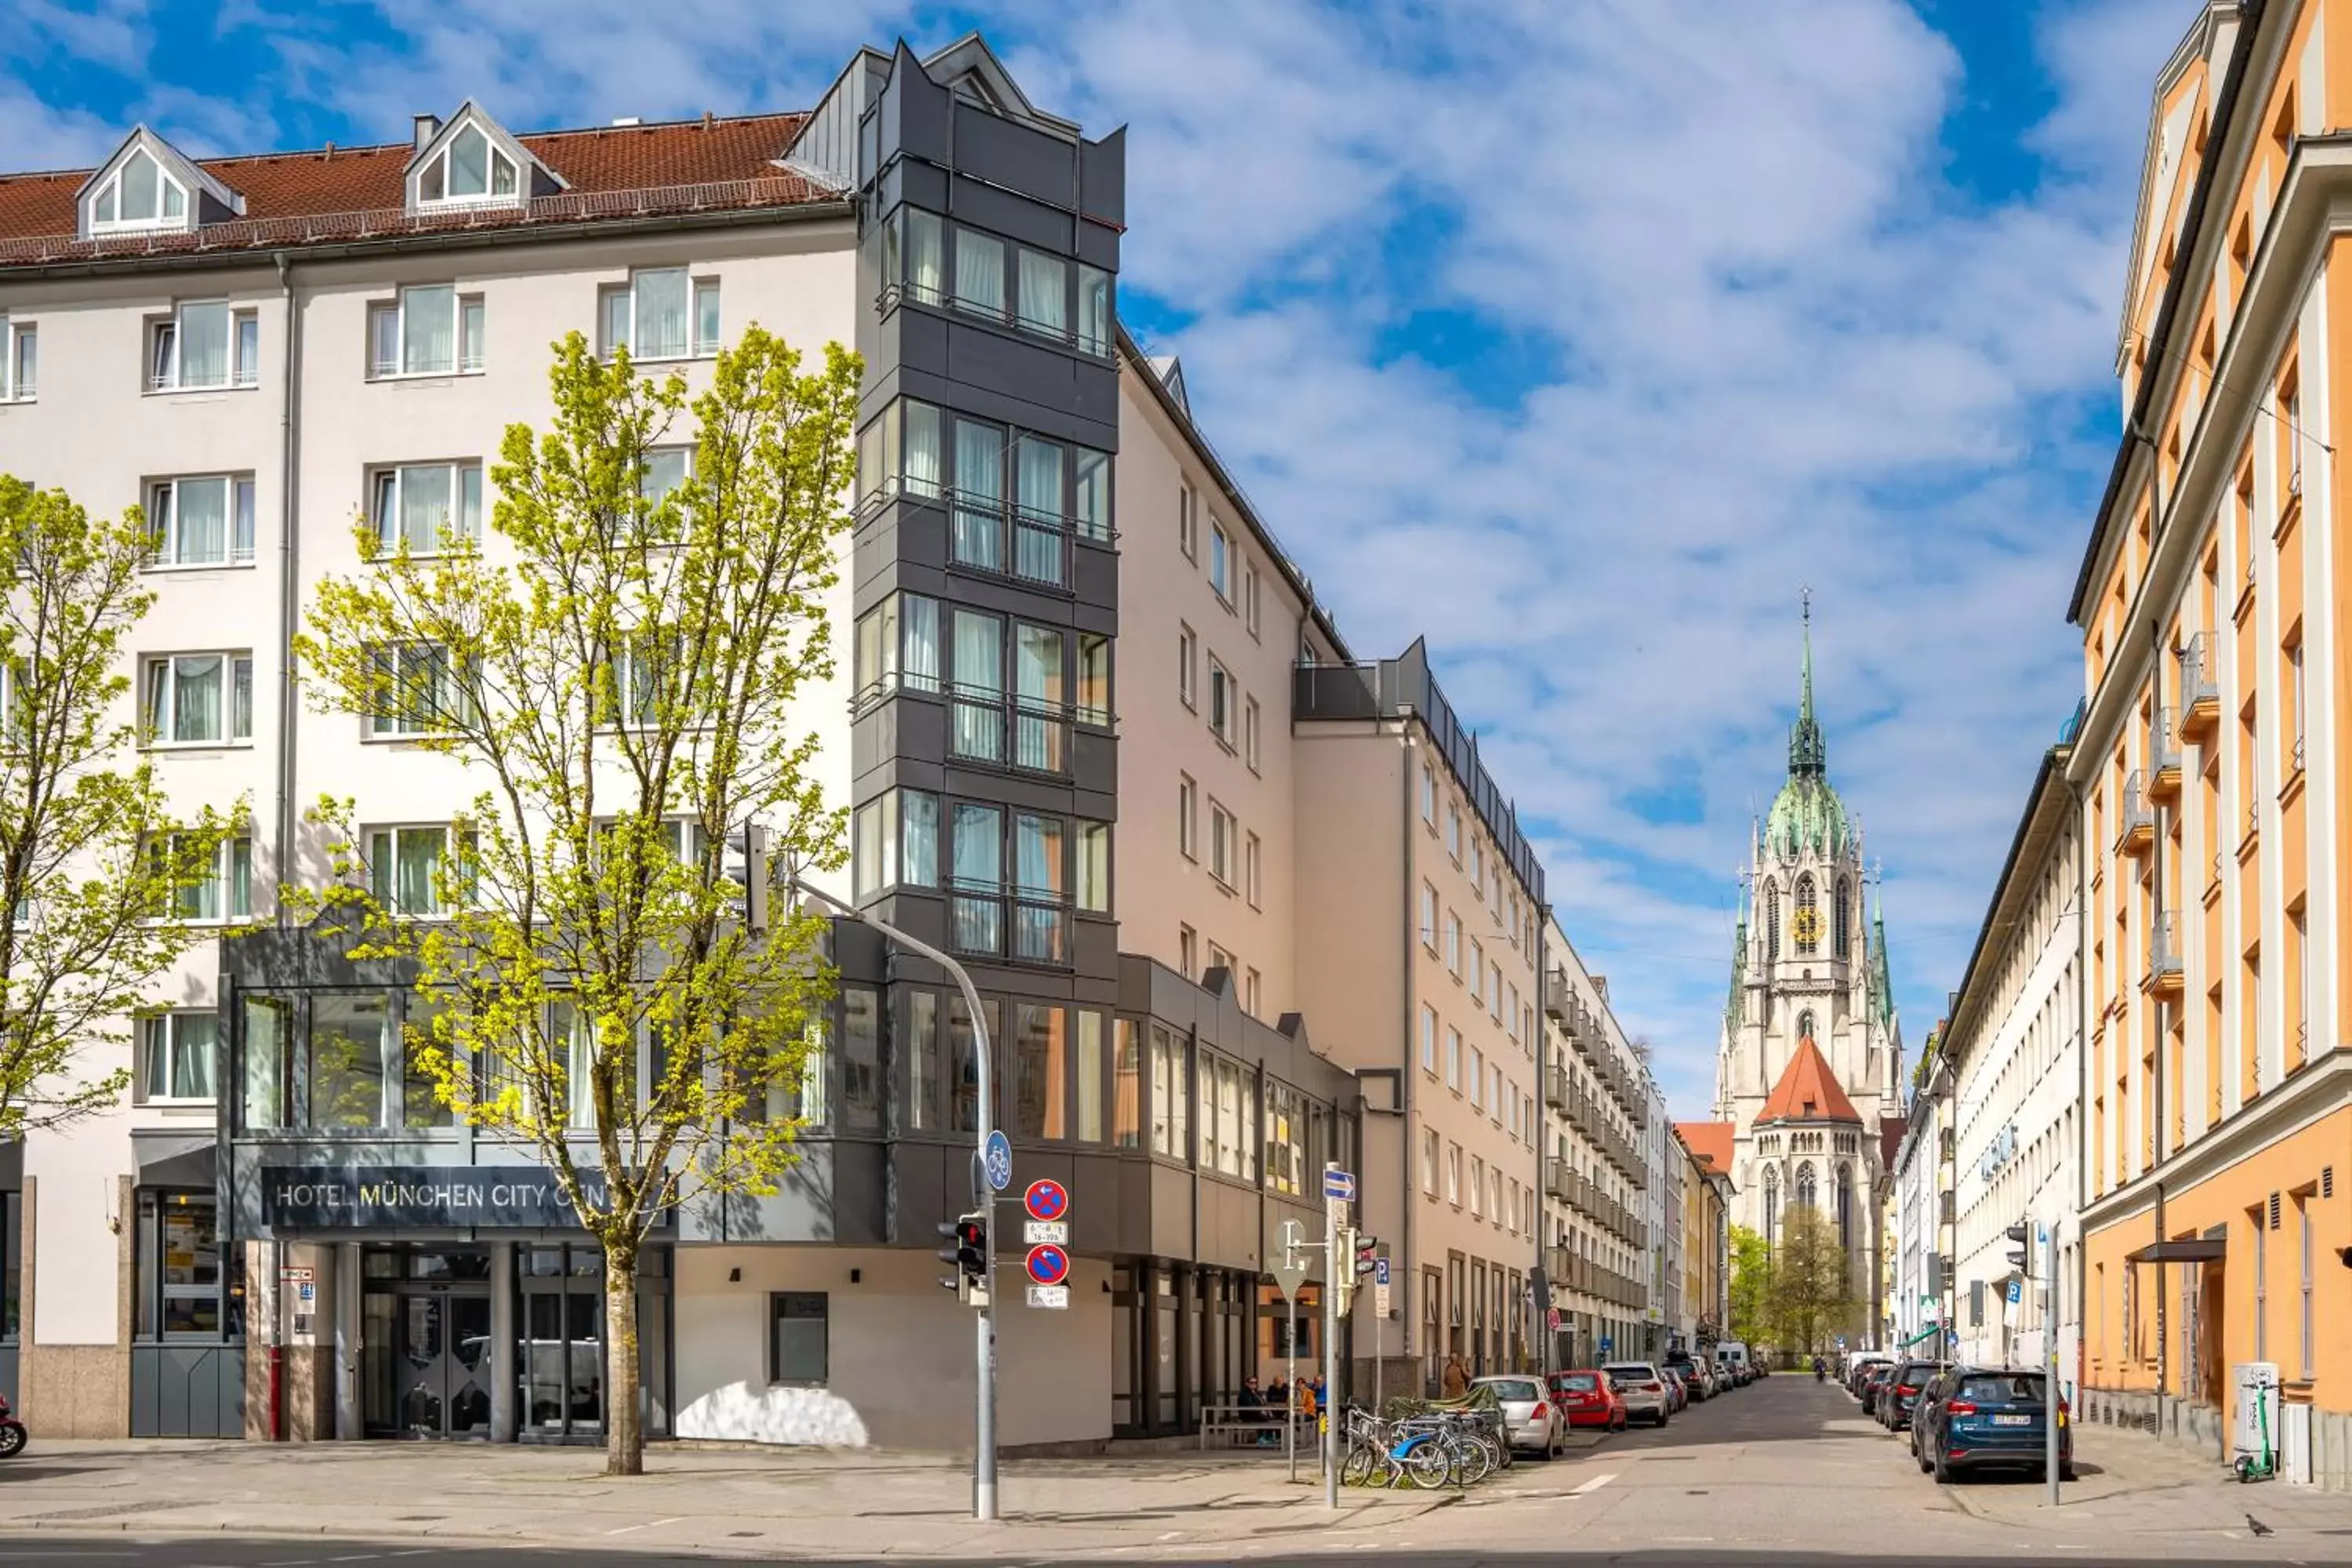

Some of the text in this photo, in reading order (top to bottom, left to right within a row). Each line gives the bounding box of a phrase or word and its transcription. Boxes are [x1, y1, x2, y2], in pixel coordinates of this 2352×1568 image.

[277, 1184, 353, 1207] HOTEL
[360, 1180, 483, 1207] MÜNCHEN
[491, 1184, 546, 1207] CITY
